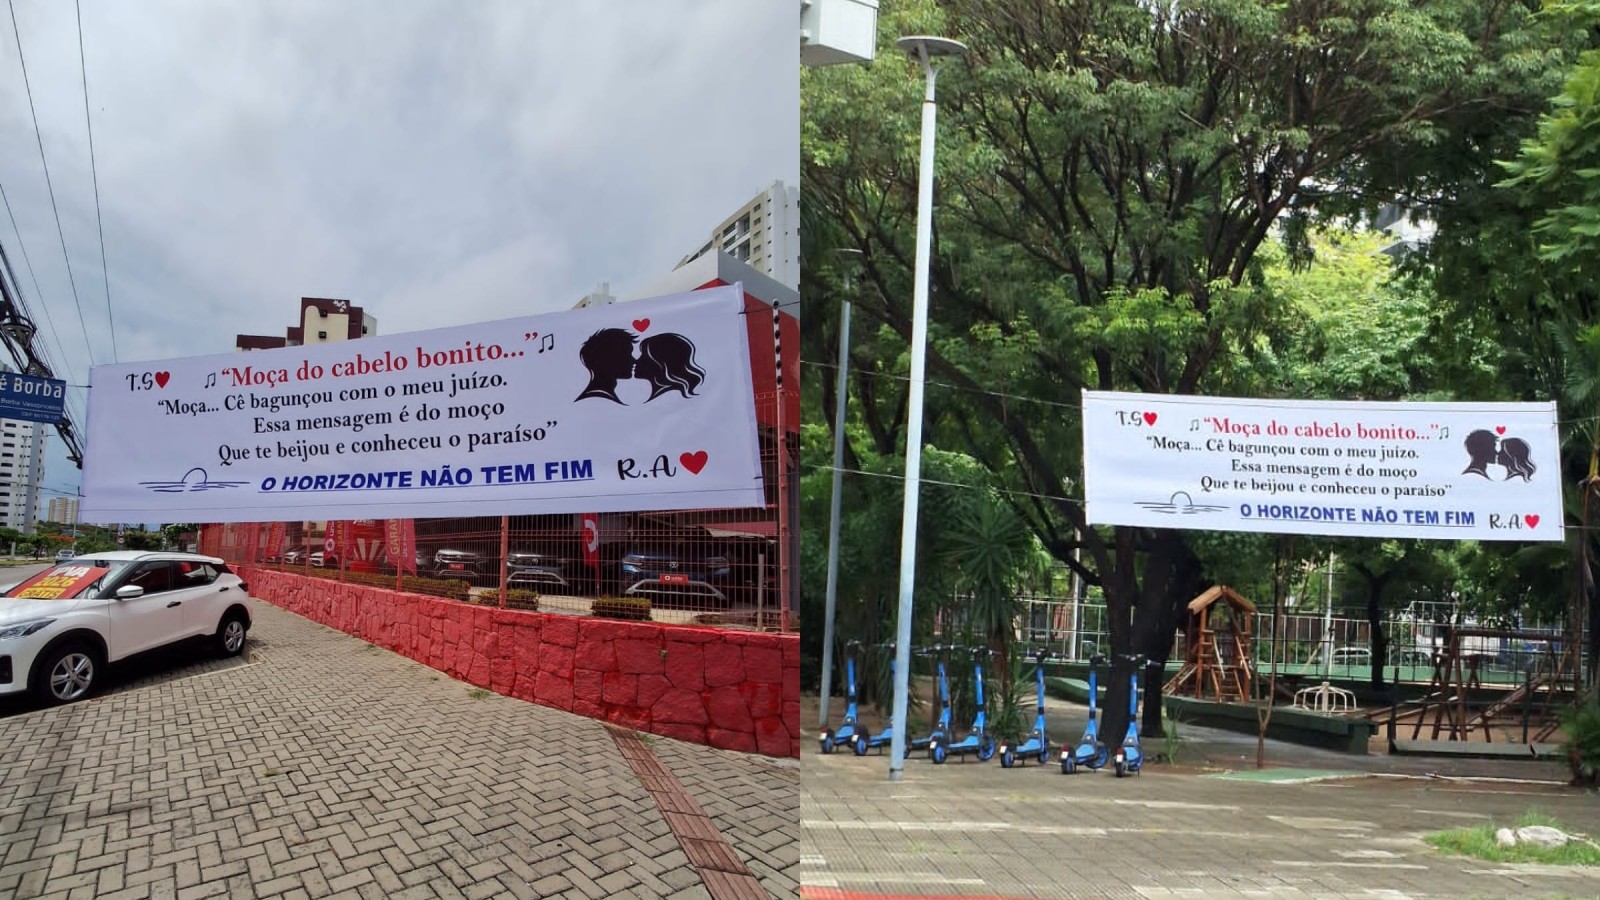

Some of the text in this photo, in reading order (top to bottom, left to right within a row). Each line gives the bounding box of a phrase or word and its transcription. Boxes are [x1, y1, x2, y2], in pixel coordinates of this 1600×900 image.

[221, 366, 289, 388] “Moça
[296, 360, 323, 380] do
[331, 351, 408, 377] cabelo
[13, 377, 62, 399] Borba
[224, 394, 245, 411] Cê
[250, 390, 333, 412] bagunçou
[339, 389, 378, 401] com
[384, 385, 395, 398] o
[402, 379, 444, 396] meu
[449, 371, 508, 398] juízo.
[253, 402, 505, 433] Essa mensagem é do moço
[1203, 417, 1261, 439] “Moça
[1267, 419, 1288, 436] do
[1294, 421, 1351, 438] cabelo
[218, 420, 558, 466] Que te beijou e conheceu o paraíso”
[1206, 439, 1225, 452] Cê
[1229, 438, 1296, 457] bagunçou
[1300, 446, 1329, 457] com
[1334, 447, 1343, 457] o
[1347, 446, 1377, 459] meu
[1380, 443, 1420, 462] juízo.
[260, 459, 593, 492] O HORIZONTE NÃO TEM FIM
[617, 454, 677, 481] R.A
[1231, 459, 1417, 480] Essa mensagem é do moço
[1200, 475, 1453, 500] Que te beijou e conheceu o paraíso”
[1240, 503, 1476, 526] O HORIZONTE NÃO TEM FIM
[33, 576, 79, 586] 2026
